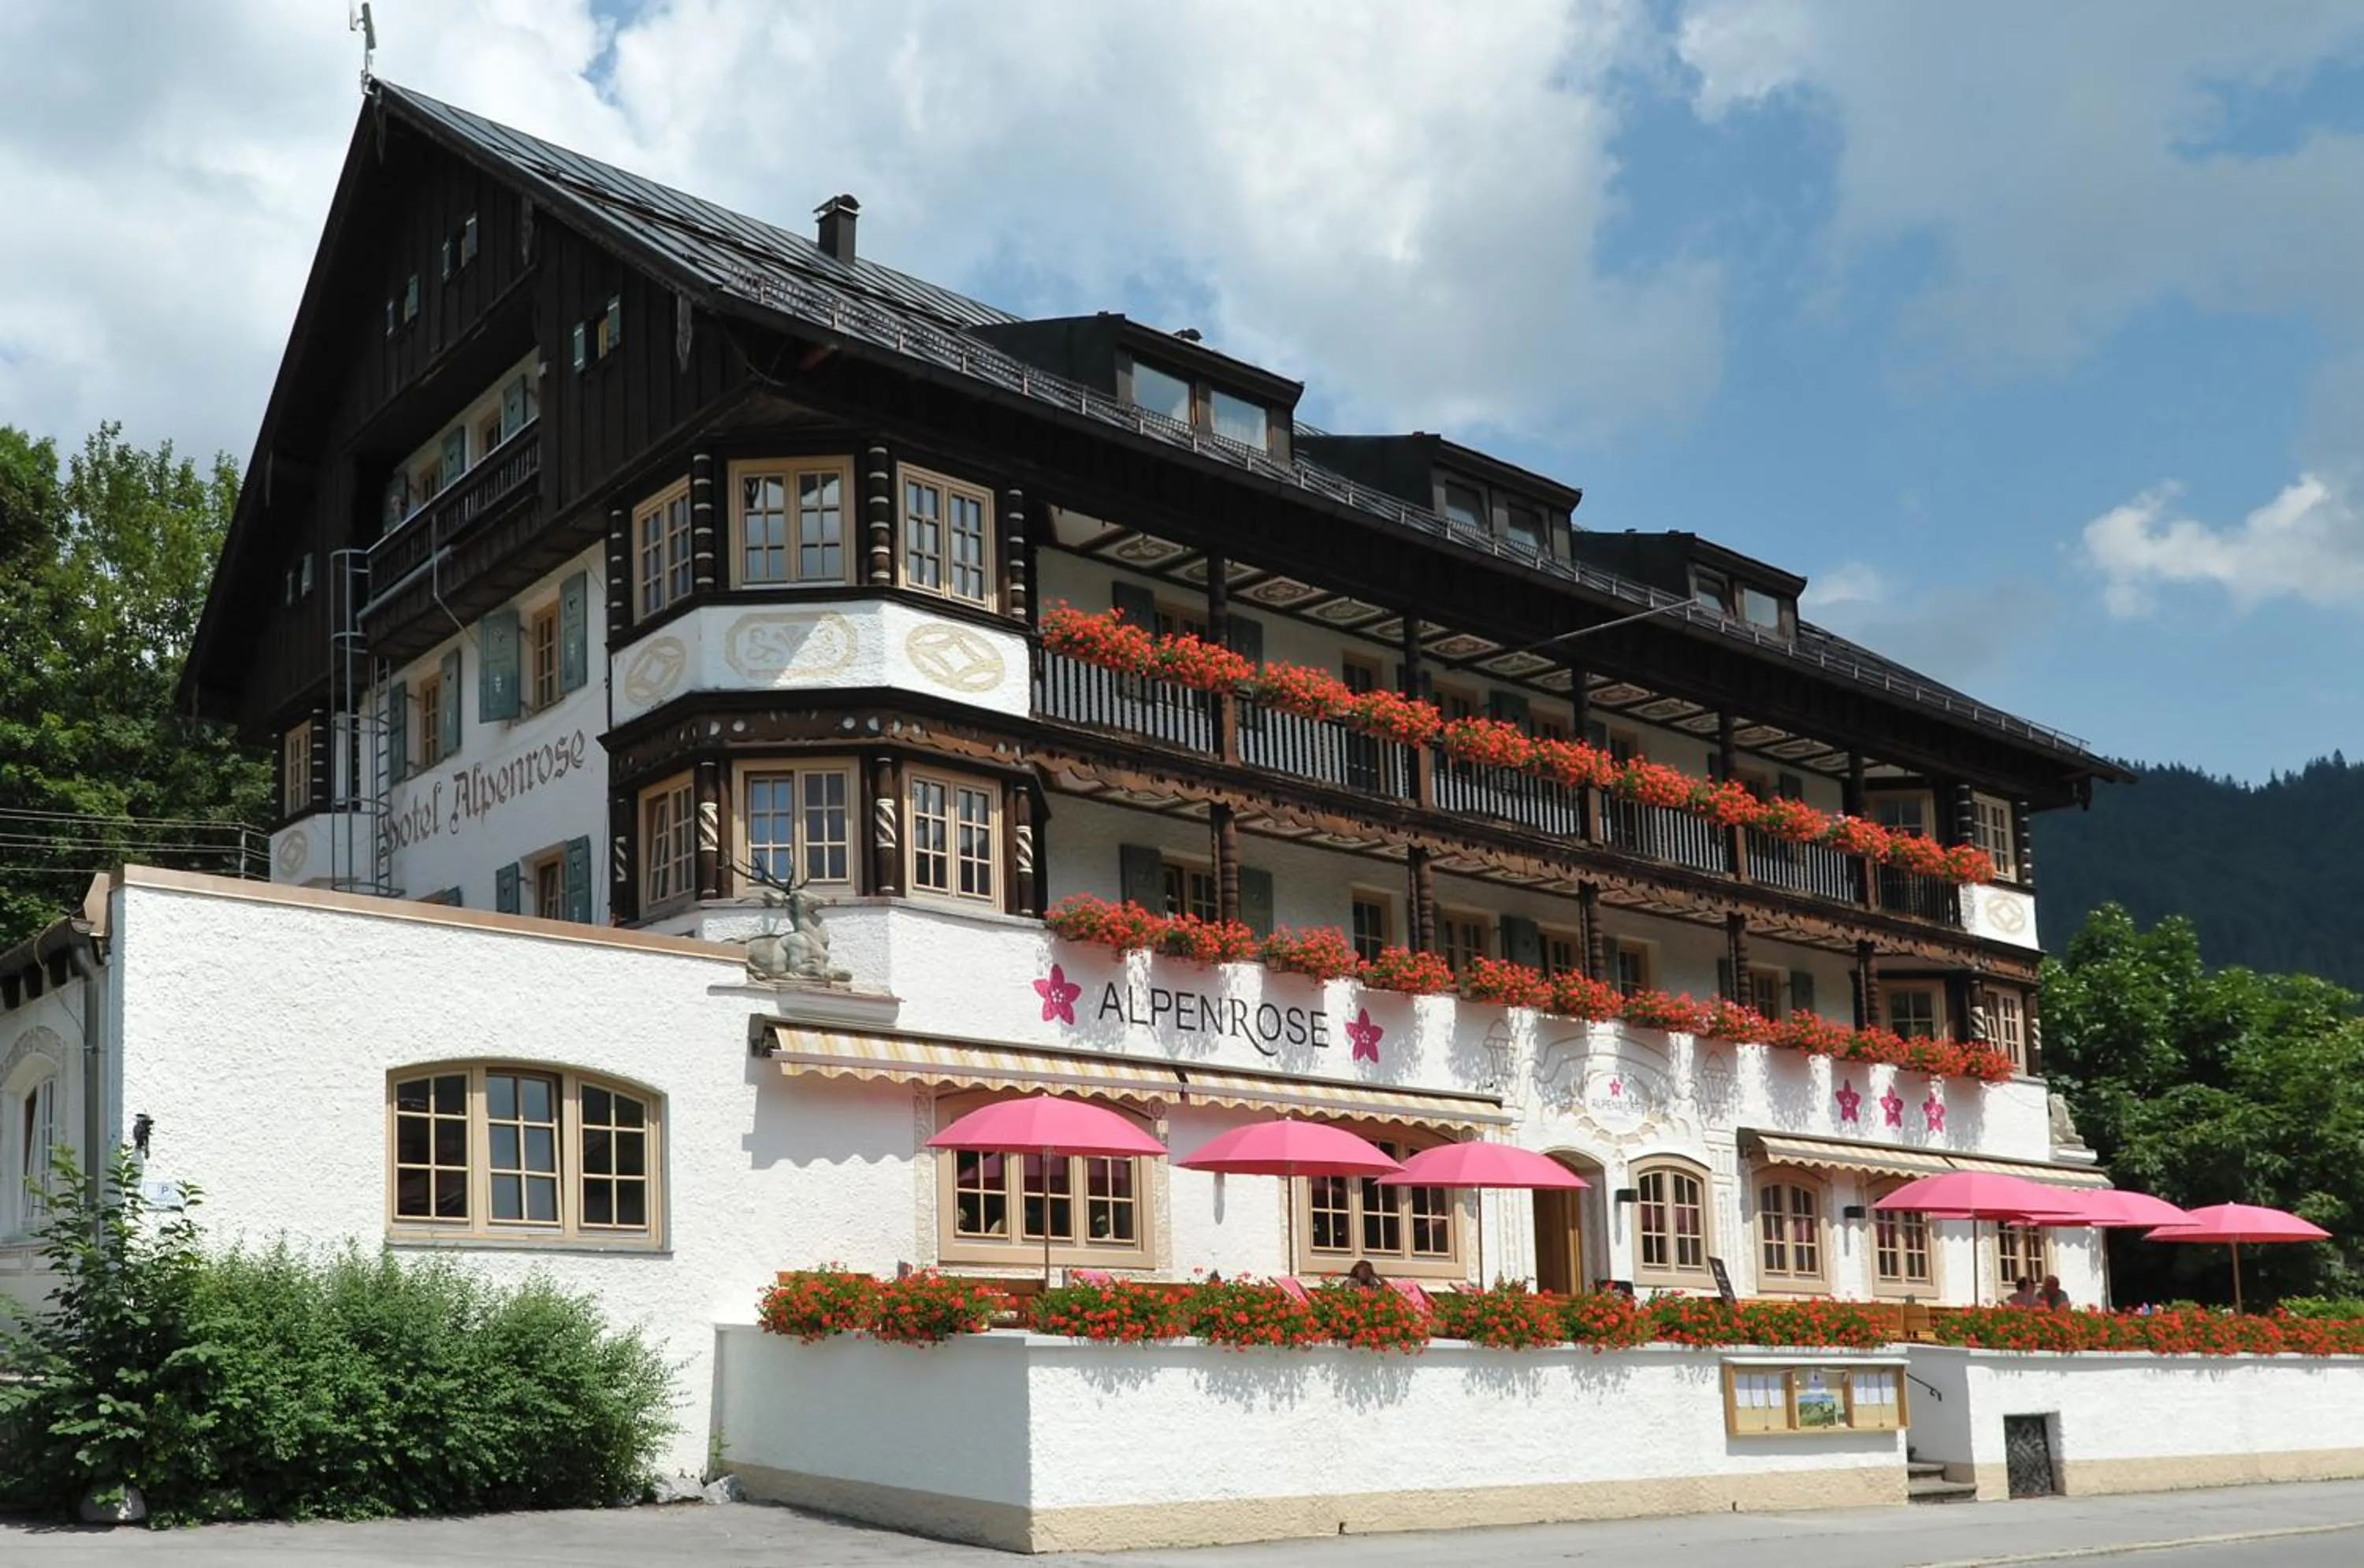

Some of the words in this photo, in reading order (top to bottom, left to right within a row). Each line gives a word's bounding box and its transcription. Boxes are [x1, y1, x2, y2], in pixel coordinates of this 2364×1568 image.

[379, 781, 441, 856] Hotel
[449, 729, 585, 835] Alpenrose
[1098, 982, 1329, 1056] ALPENROSE
[1591, 1098, 1643, 1116] ALPEN
[162, 1186, 169, 1195] P
